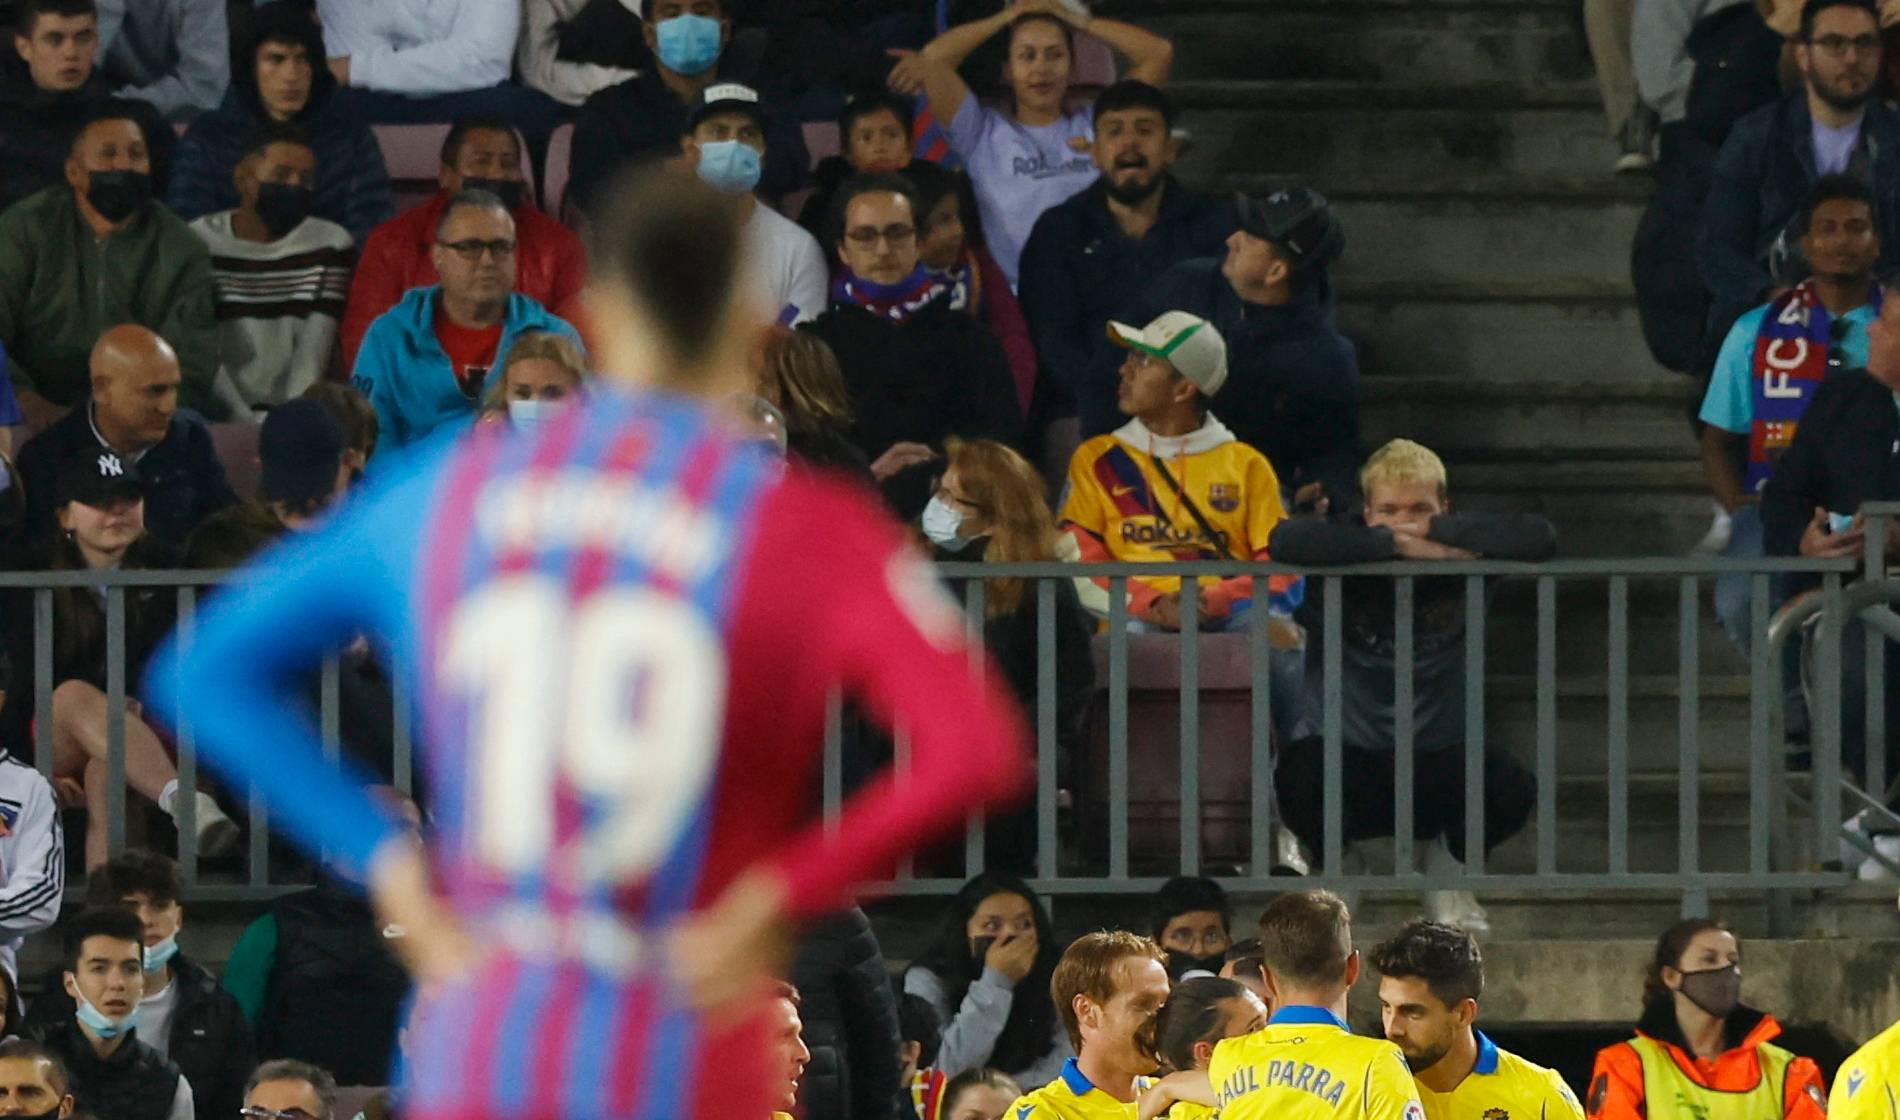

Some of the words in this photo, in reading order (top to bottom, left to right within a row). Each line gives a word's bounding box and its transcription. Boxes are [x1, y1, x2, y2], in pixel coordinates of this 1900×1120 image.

[1763, 336, 1808, 398] FC
[438, 570, 728, 880] 19
[1266, 1060, 1346, 1106] PARRA
